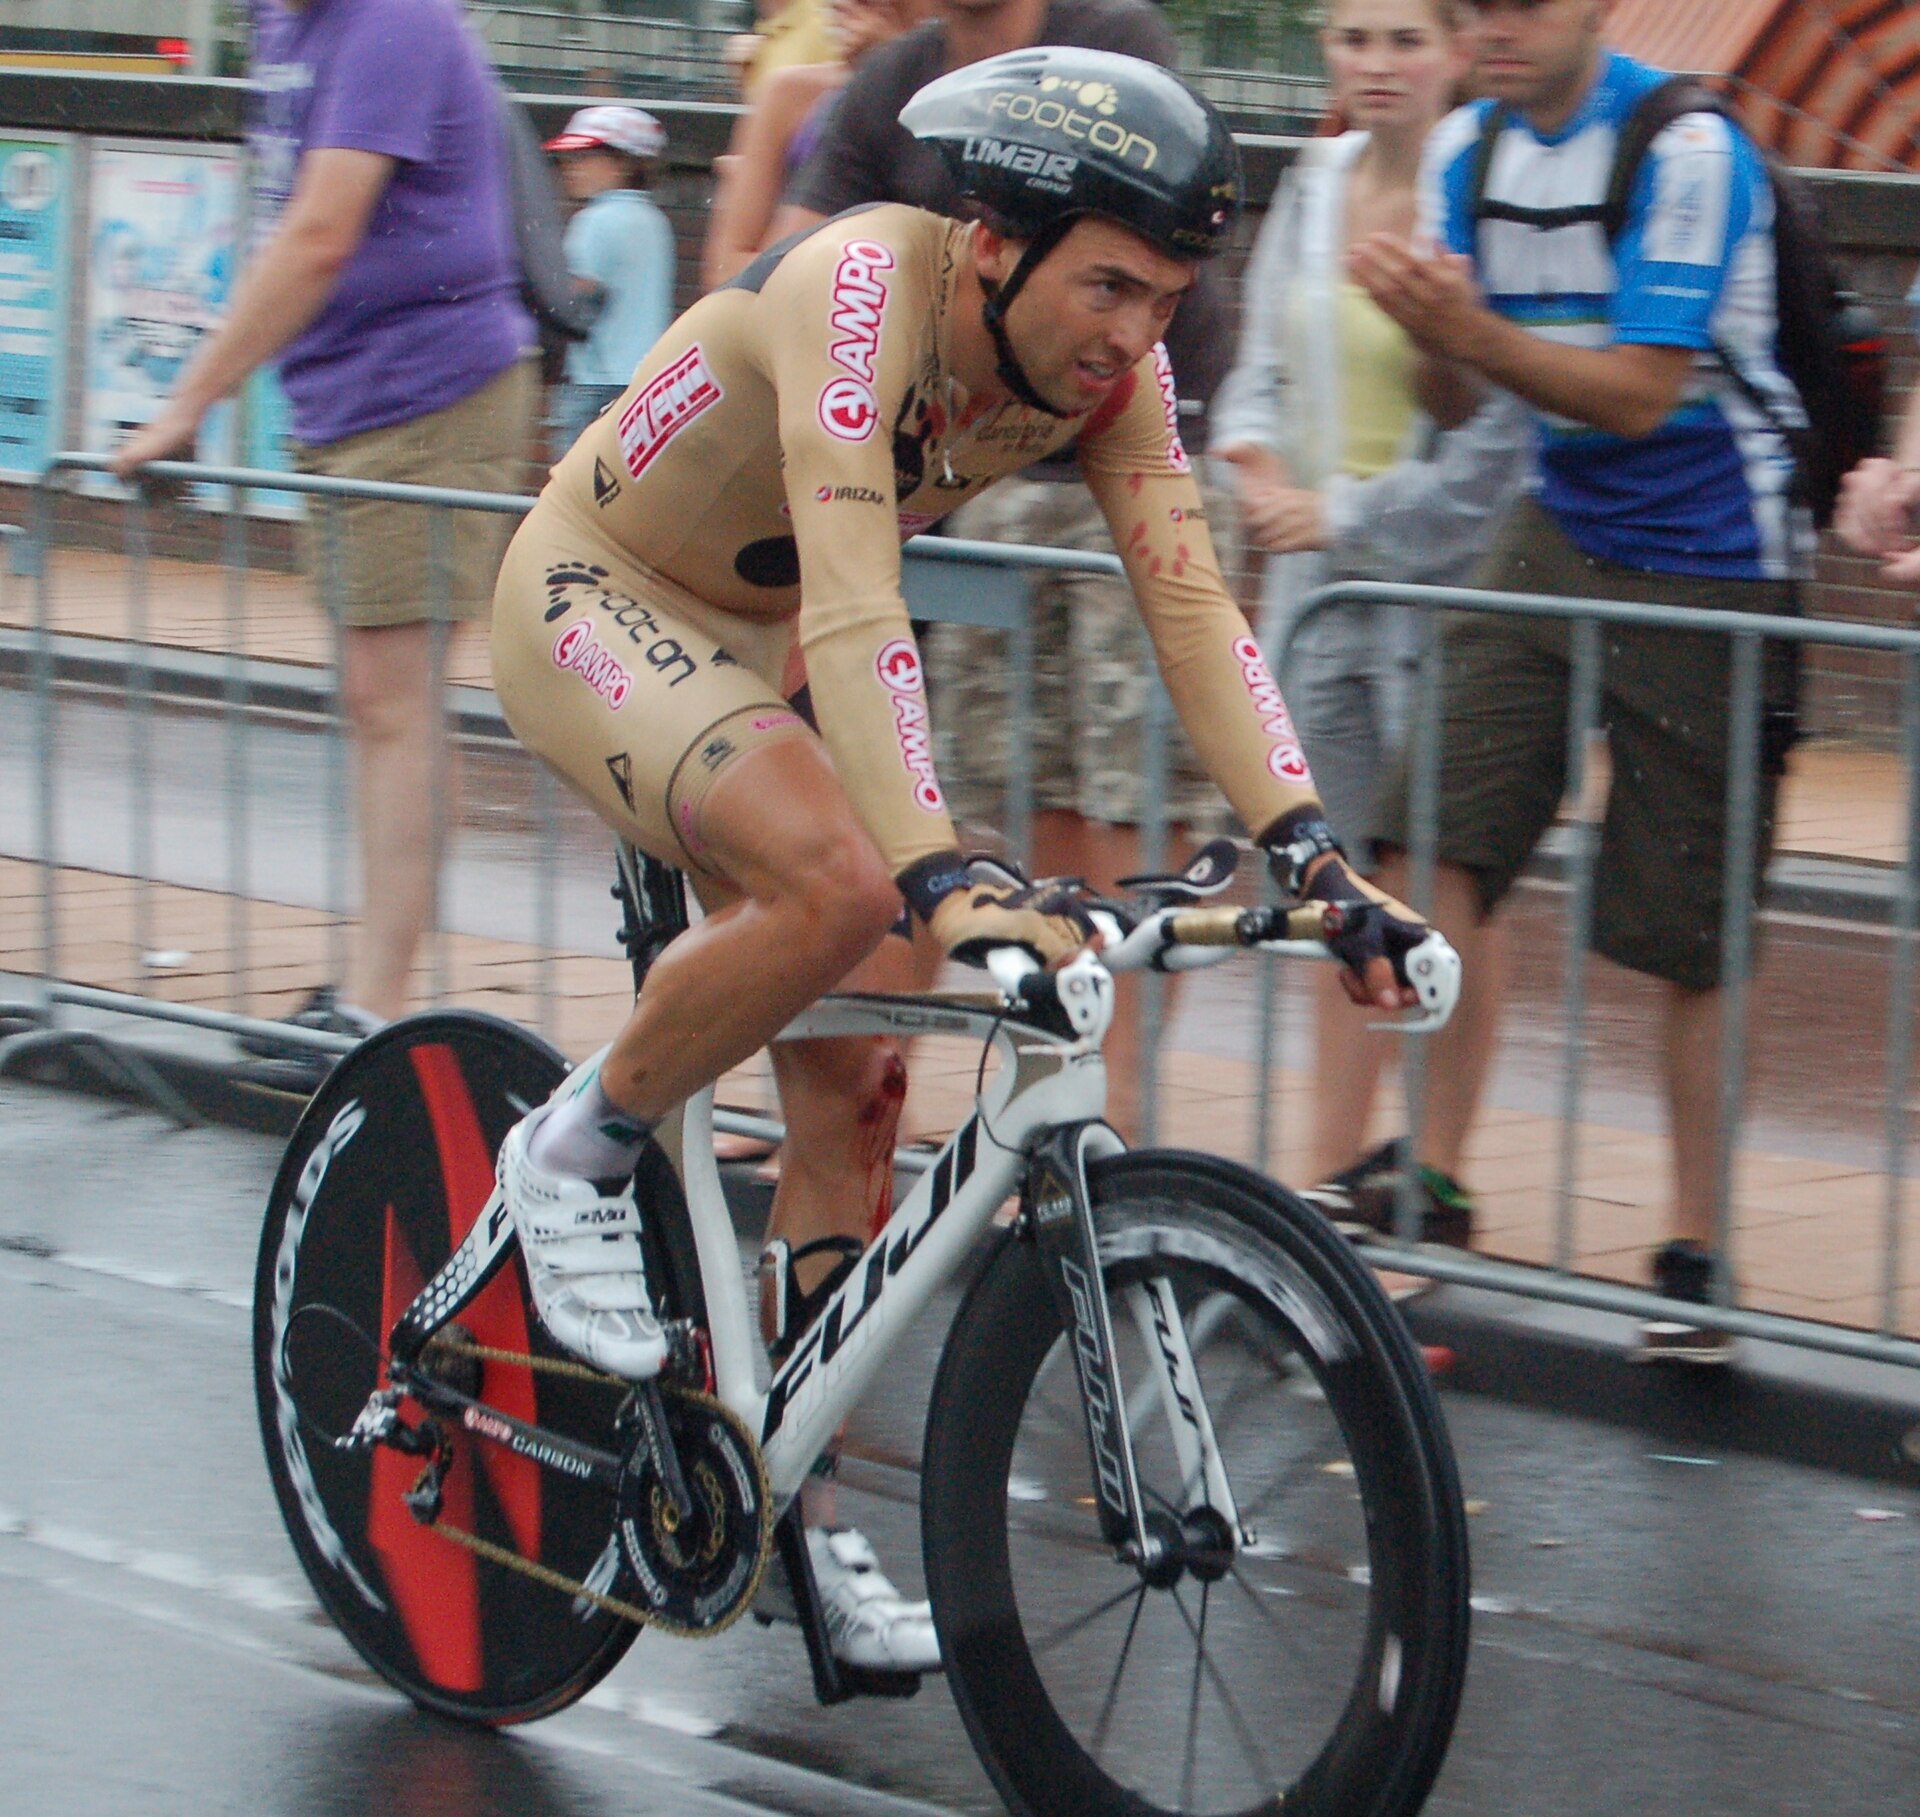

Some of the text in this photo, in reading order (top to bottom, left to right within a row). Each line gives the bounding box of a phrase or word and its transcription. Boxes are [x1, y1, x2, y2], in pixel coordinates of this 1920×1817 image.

[830, 239, 894, 383] AMPO
[573, 641, 632, 711] AMPO
[1232, 635, 1296, 742] AMPO
[892, 695, 944, 813] AMPO
[512, 1434, 592, 1480] CARBON
